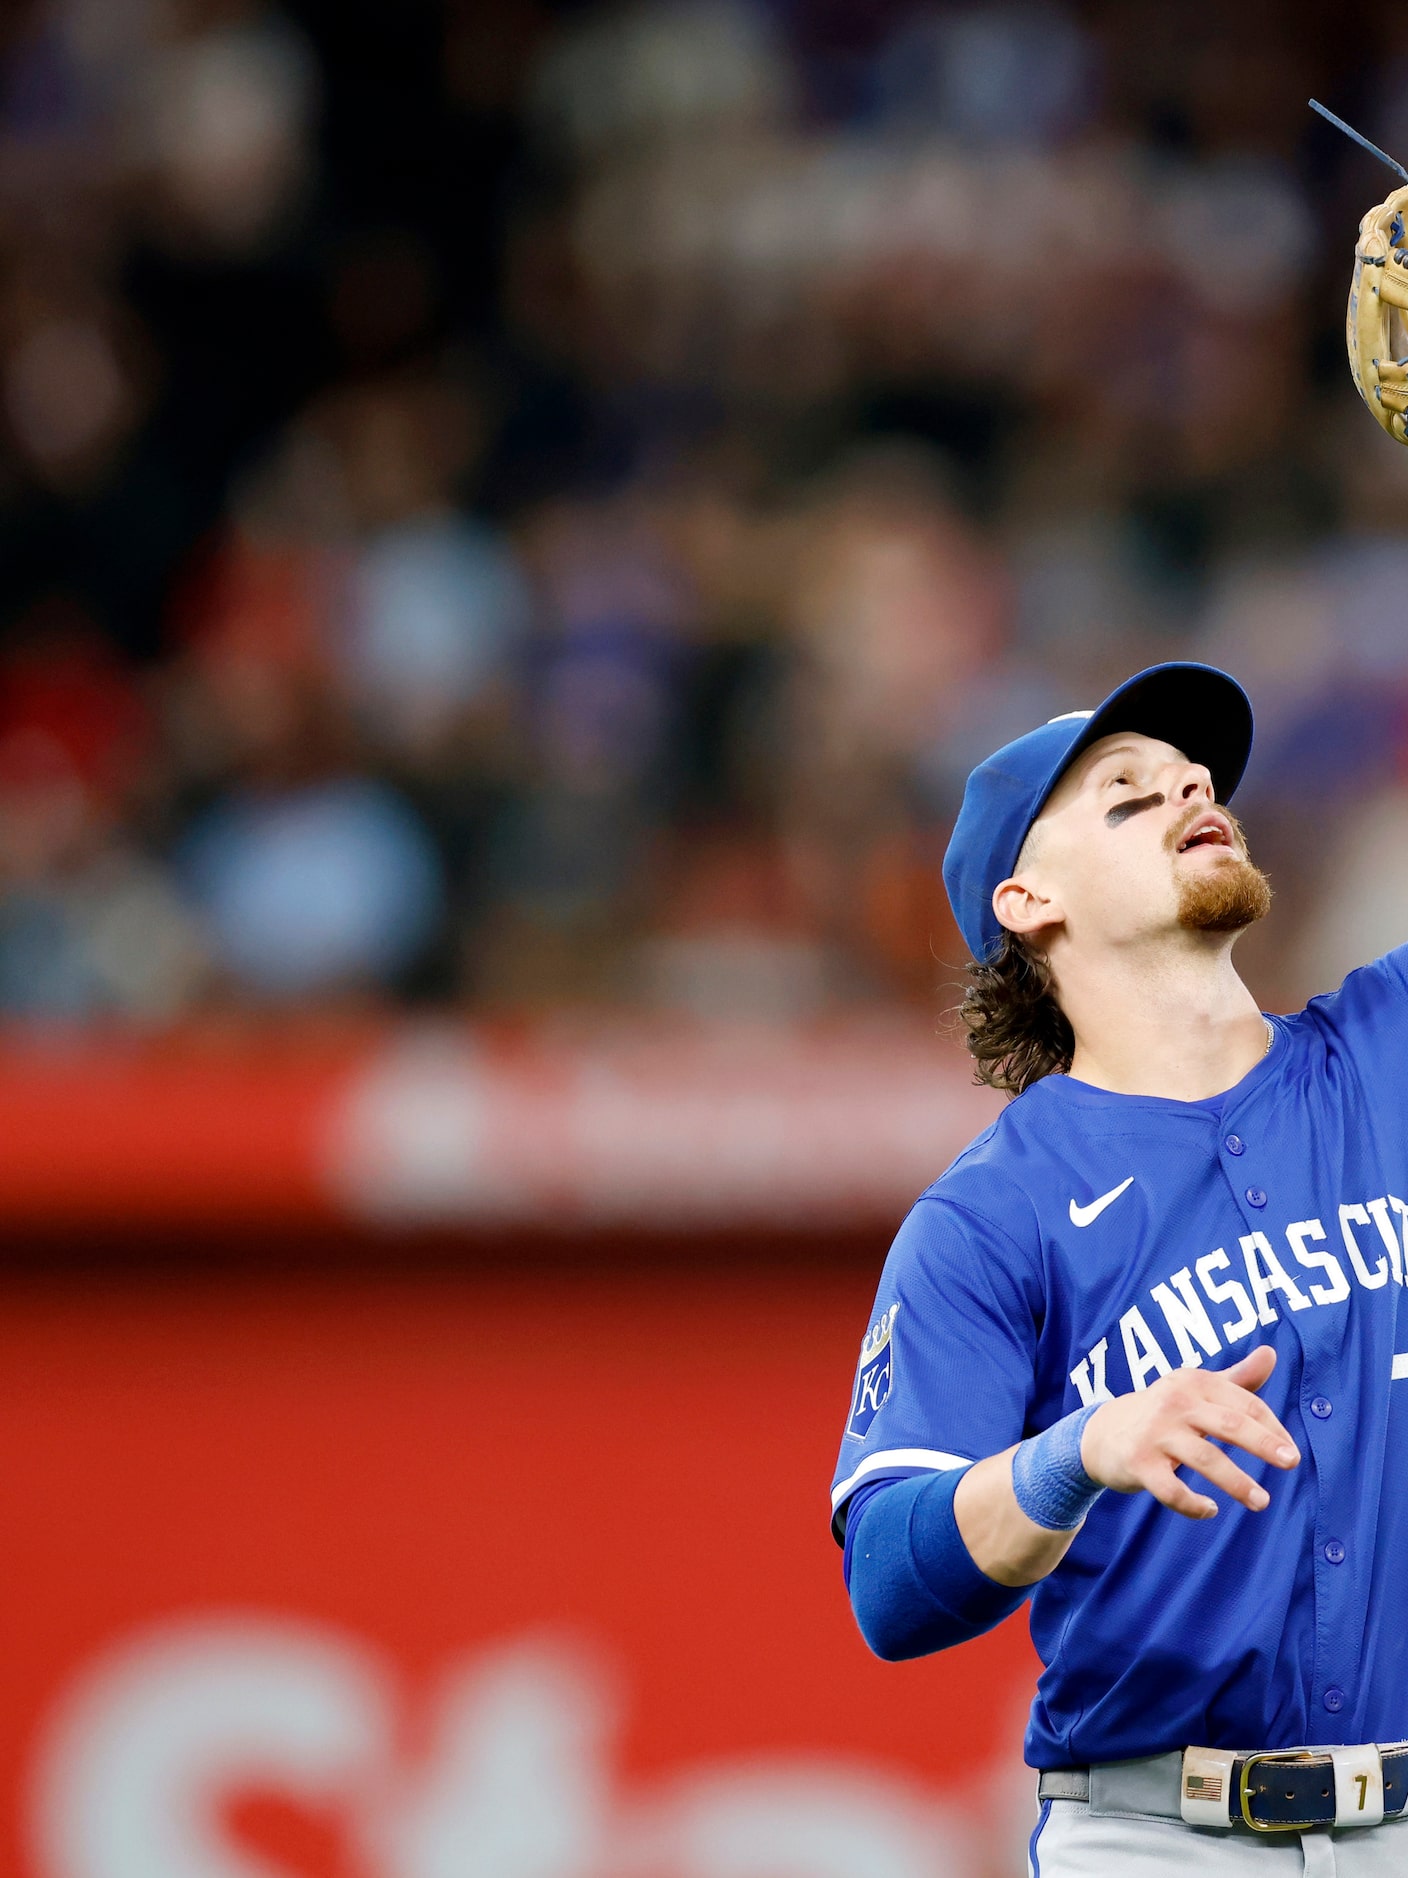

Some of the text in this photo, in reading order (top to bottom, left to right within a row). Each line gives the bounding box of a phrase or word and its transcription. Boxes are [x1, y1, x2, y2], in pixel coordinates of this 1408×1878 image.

[1069, 1218, 1351, 1403] KANSAS
[855, 1362, 890, 1416] KC
[1354, 1774, 1368, 1811] 7
